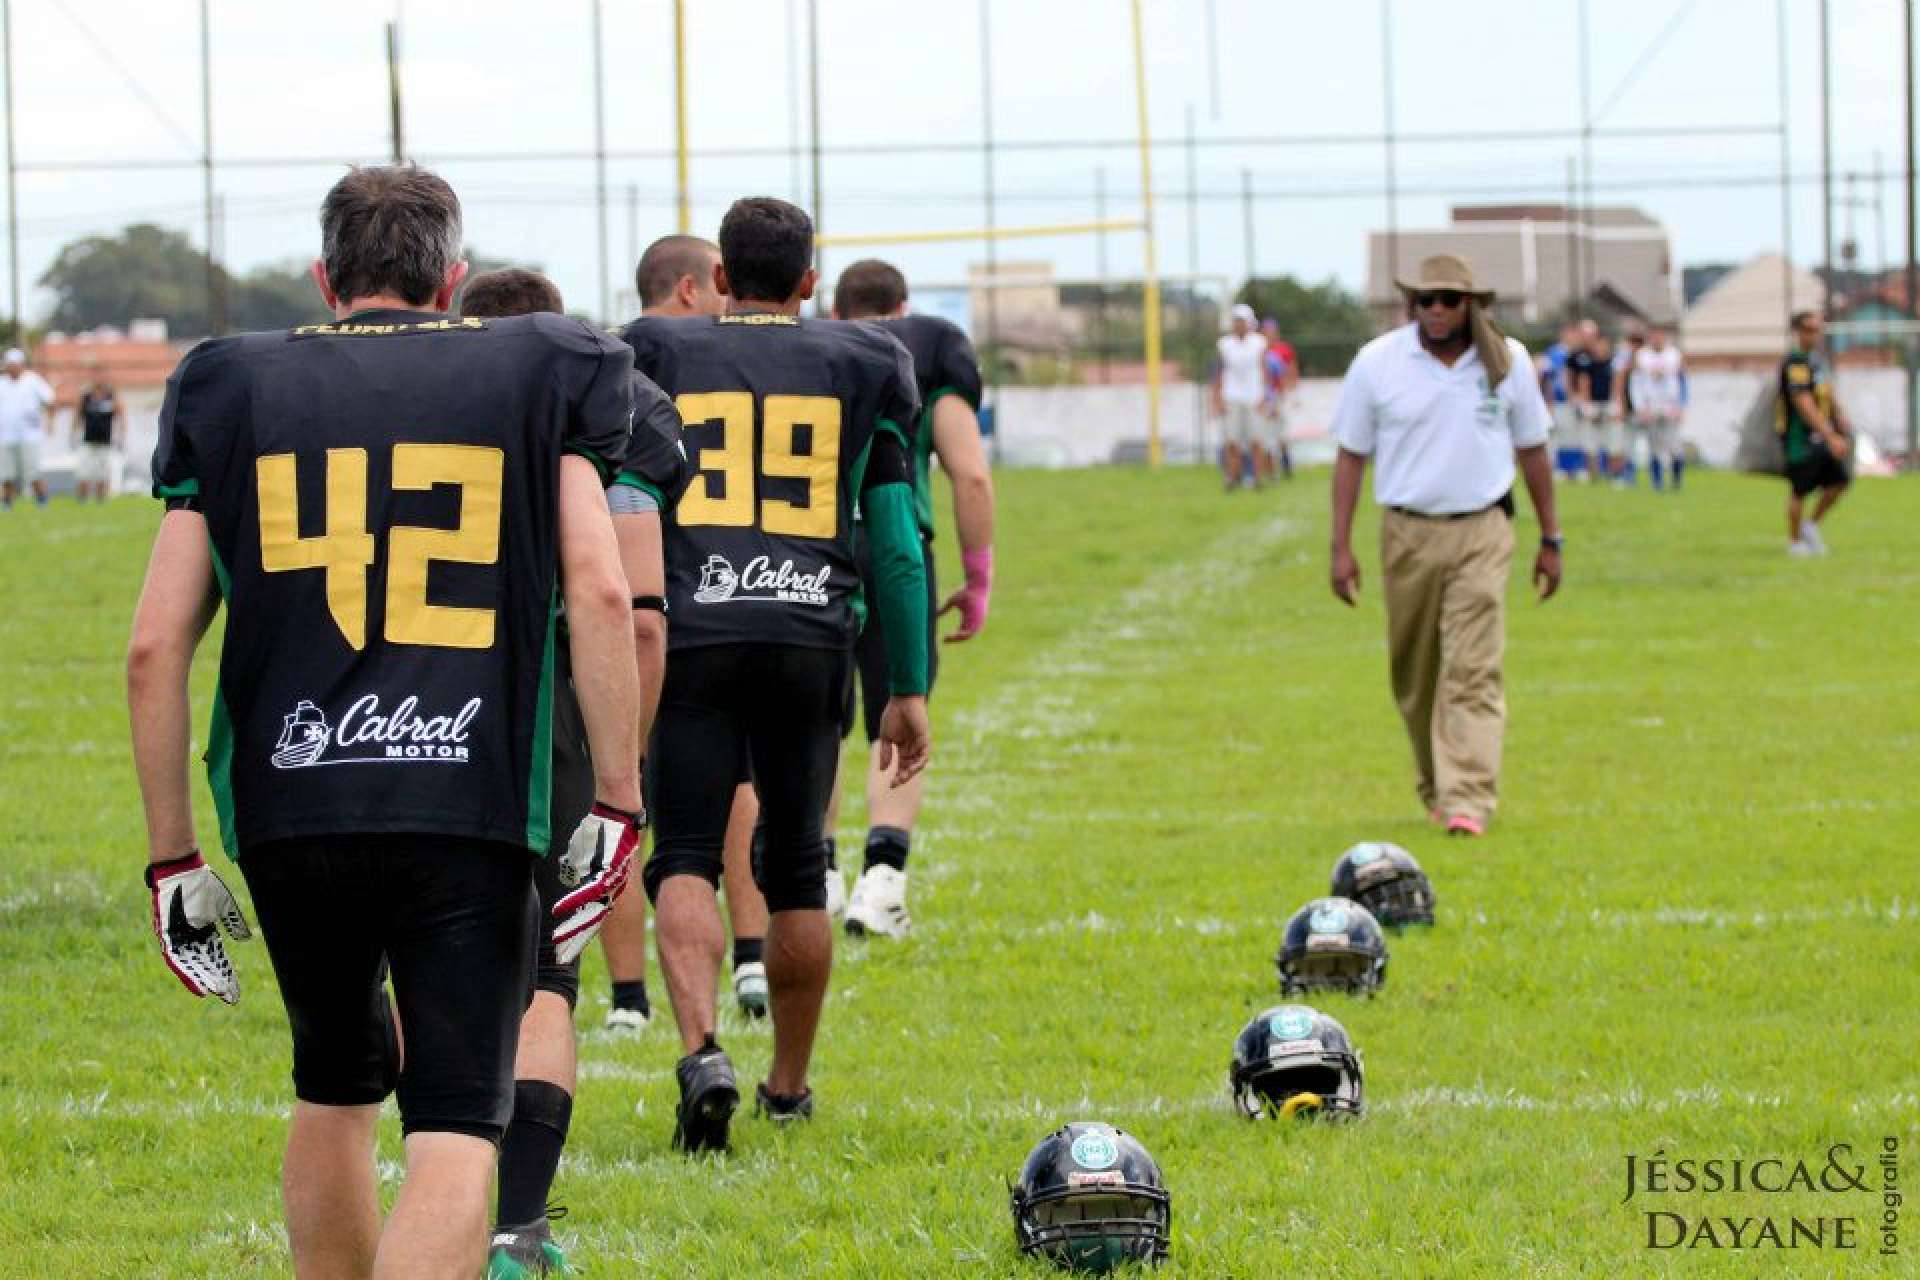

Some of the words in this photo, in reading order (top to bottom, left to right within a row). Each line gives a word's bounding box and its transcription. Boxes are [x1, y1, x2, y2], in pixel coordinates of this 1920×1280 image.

[675, 390, 842, 538] 39
[255, 442, 505, 651] 42
[741, 555, 831, 593] Cabral
[337, 693, 482, 747] Cabral
[385, 745, 469, 758] MOTOR
